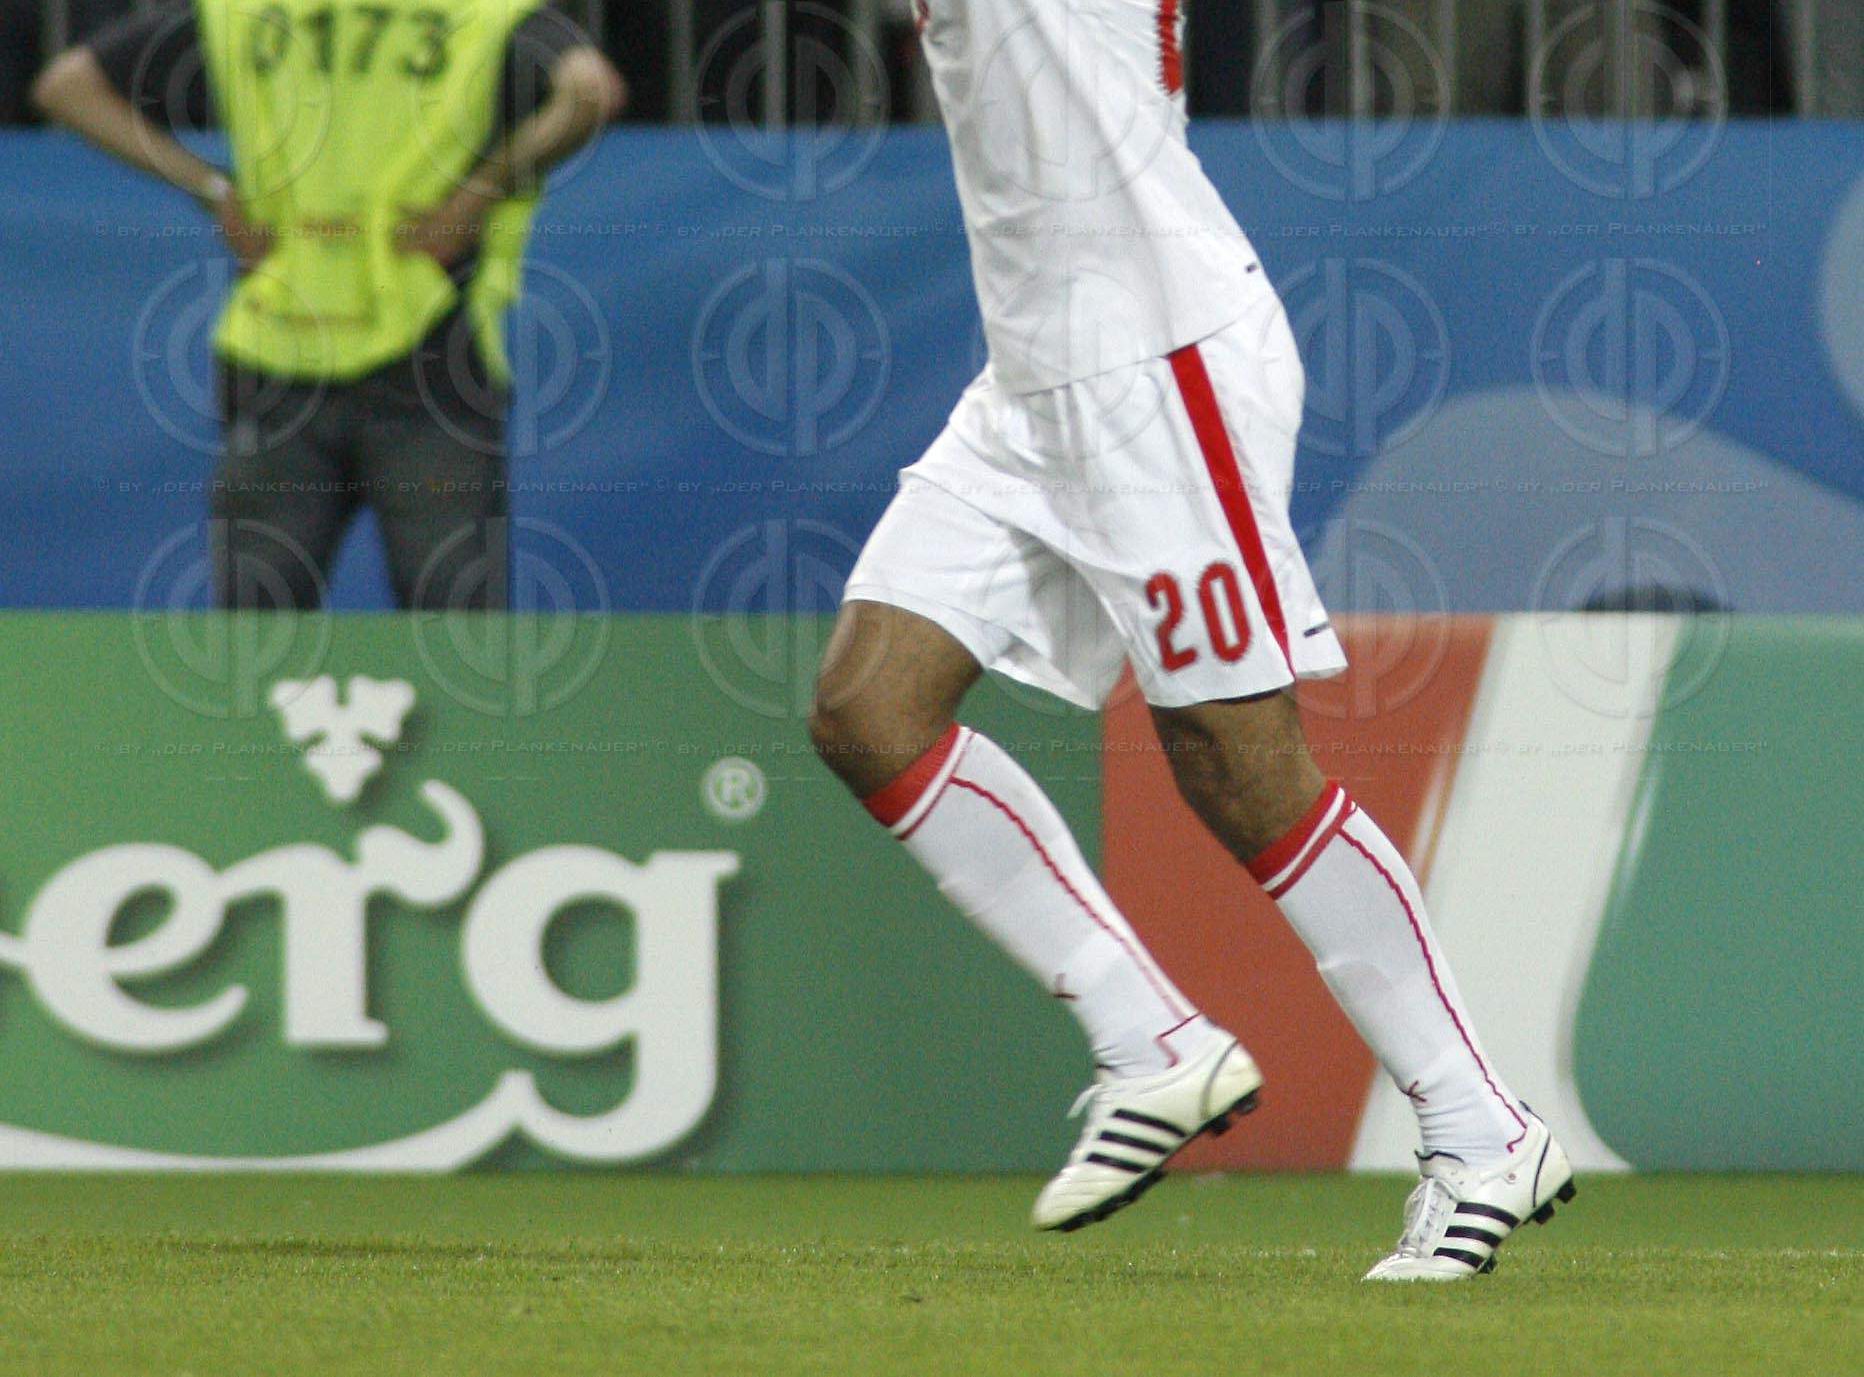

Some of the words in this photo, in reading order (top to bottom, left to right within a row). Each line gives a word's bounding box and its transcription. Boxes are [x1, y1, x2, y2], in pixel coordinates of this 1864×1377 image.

[242, 3, 450, 75] 0173
[1145, 561, 1251, 673] 20
[0, 780, 740, 1161] erg
